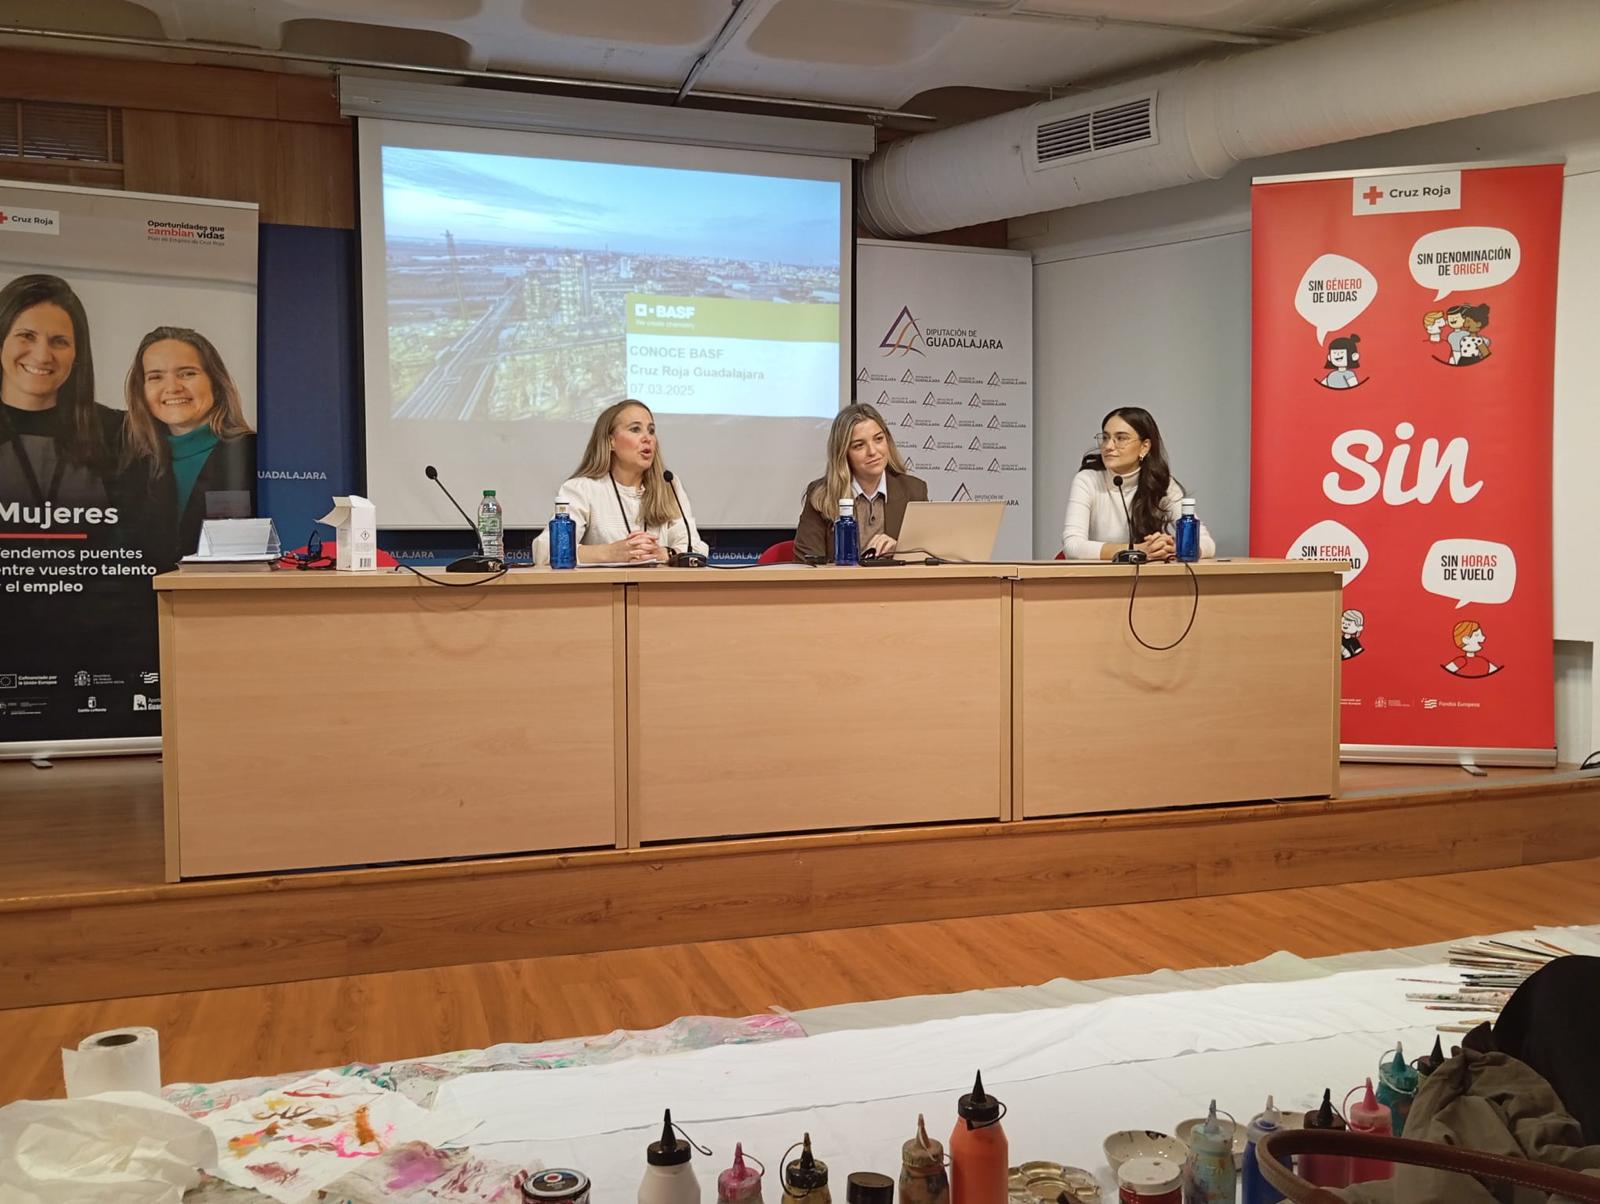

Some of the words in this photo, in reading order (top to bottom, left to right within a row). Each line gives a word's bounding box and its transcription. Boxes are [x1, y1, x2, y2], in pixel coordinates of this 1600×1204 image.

[1389, 188, 1419, 198] Cruz
[1423, 185, 1451, 198] Roja
[11, 215, 32, 224] Cruz
[34, 217, 54, 227] Roja
[147, 220, 208, 231] Oportunidades
[148, 228, 194, 238] cambian
[196, 230, 225, 240] vidas
[1417, 252, 1433, 265] SIN
[1436, 246, 1512, 264] DENOMINACIÓN
[1438, 265, 1451, 276] DE
[1453, 263, 1490, 276] ORIGEN
[1308, 280, 1324, 292] SIN
[1326, 278, 1362, 292] GÉNERO
[1312, 292, 1324, 303] DE
[1326, 291, 1358, 302] DUDAS
[656, 305, 696, 320] BASF
[926, 328, 967, 337] DIPUTACIÓN
[968, 330, 977, 338] DE
[926, 338, 1004, 350] GUADALAJARA
[630, 345, 686, 358] CONOCE
[690, 348, 724, 360] BASF
[630, 364, 658, 376] Cruz
[662, 366, 690, 378] Roja
[693, 367, 764, 381] Guadalajara
[630, 384, 694, 396] 07.03.2025
[1322, 422, 1484, 506] Sin
[256, 470, 326, 480] UADALAJARA
[0, 501, 119, 530] Mujeres
[0, 547, 76, 559] endemos
[80, 548, 143, 562] puentes
[386, 551, 435, 560] ALAJARA
[712, 552, 761, 560] GUADALAJ
[1301, 546, 1317, 558] SIN
[1320, 545, 1351, 558] FECHA
[1440, 555, 1458, 568] SIN
[1461, 554, 1498, 568] HORAS
[0, 564, 35, 576] ntre
[39, 564, 98, 576] vuestro
[101, 564, 158, 576] talento
[1444, 569, 1457, 580] DE
[1460, 569, 1494, 580] VUELO
[6, 581, 20, 592] el
[23, 580, 84, 595] empleo
